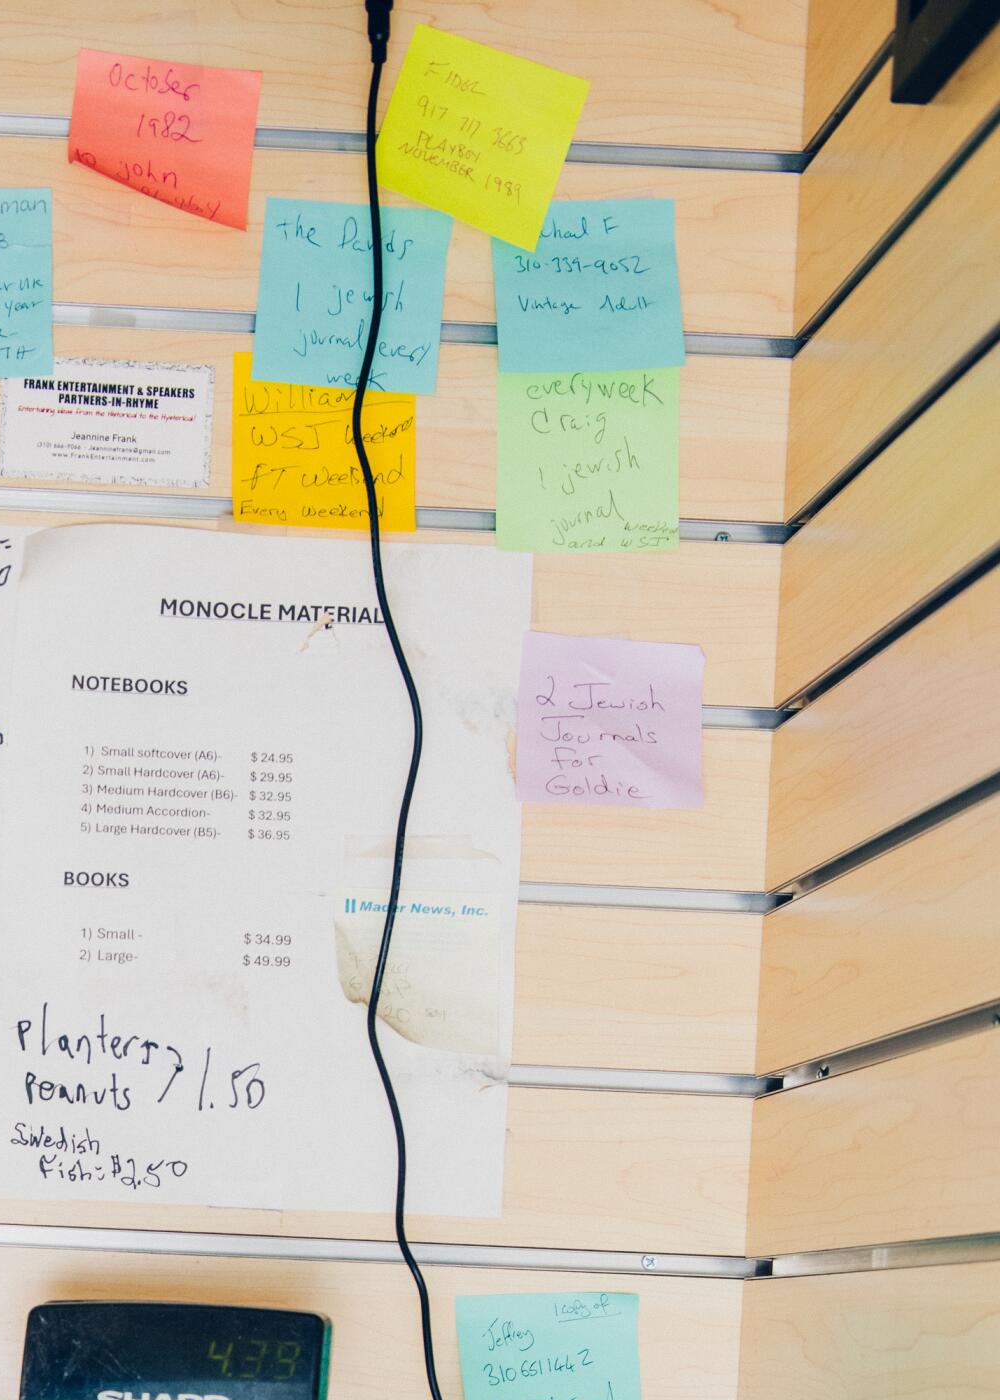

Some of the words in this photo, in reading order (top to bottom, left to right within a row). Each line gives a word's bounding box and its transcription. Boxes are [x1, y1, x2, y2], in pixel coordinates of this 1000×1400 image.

[109, 63, 201, 101] October
[417, 95, 449, 120] 917
[137, 111, 203, 142] 1982
[416, 130, 480, 162] PLAYBOY
[116, 160, 178, 189] john
[398, 142, 475, 183] NOVEMBER
[485, 175, 522, 208] 1989
[603, 217, 619, 234] F
[515, 255, 650, 275] 310-339-9052
[19, 278, 44, 290] UK
[518, 295, 582, 314] Vintage
[293, 318, 365, 357] journal
[378, 341, 433, 366] every
[23, 378, 55, 391] FRANK
[57, 380, 134, 396] ENTERTAINMENT
[137, 387, 144, 397] &
[146, 386, 195, 399] SPEAKERS
[58, 393, 159, 409] PARTNERS-IN-RHYME
[251, 420, 342, 449] WSJ
[531, 408, 607, 444] Craig
[70, 432, 110, 442] Jeannine
[112, 433, 137, 444] Frank
[561, 435, 641, 495] jewish
[240, 499, 287, 521] Every
[550, 489, 625, 546] journal
[160, 598, 271, 621] MONOCLE
[71, 674, 189, 695] NOTEBOOKS
[535, 675, 556, 707] 2
[568, 682, 665, 712] Jewish
[540, 714, 658, 744] Journals
[101, 746, 135, 758] Small
[137, 748, 191, 760] softcover
[98, 765, 131, 777] Small
[134, 767, 194, 780] Hardcover
[97, 784, 145, 797] Medium
[148, 786, 208, 799] Hardcover
[545, 774, 653, 799] Goldie
[96, 804, 143, 816] Medium
[95, 823, 127, 836] Large
[130, 824, 190, 837] Hardcover
[63, 871, 130, 888] BOOKS
[410, 903, 456, 918] News,
[461, 905, 489, 916] Inc.
[97, 927, 134, 940] Small
[198, 1047, 265, 1111] 1.50
[11, 1122, 101, 1155] Swedish
[482, 1318, 535, 1352] Jeffrey
